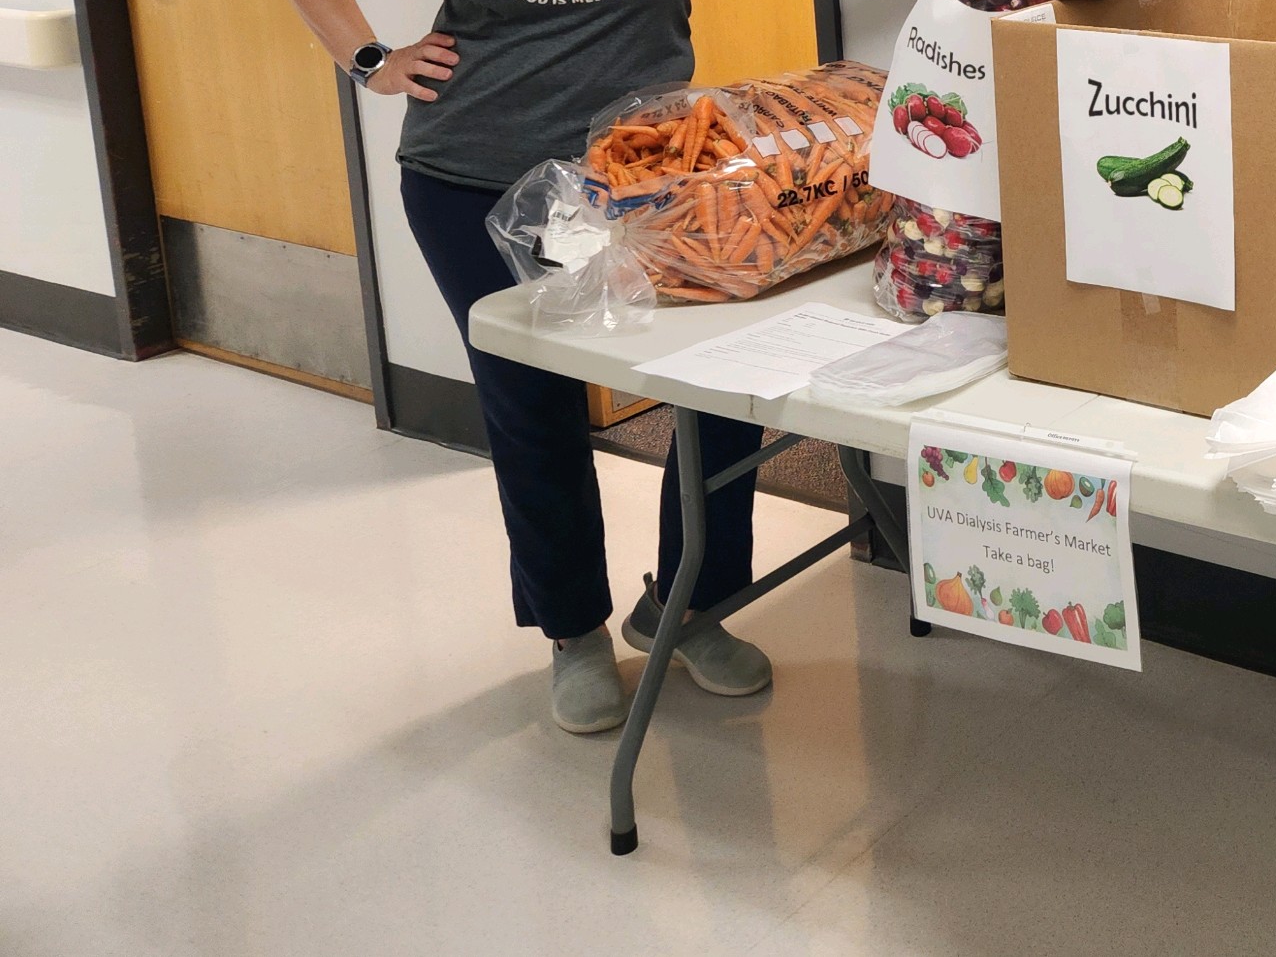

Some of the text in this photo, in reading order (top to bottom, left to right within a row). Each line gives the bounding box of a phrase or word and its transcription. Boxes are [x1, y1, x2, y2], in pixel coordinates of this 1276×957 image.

[906, 26, 986, 80] Radishes
[1087, 78, 1198, 129] Zucchini
[927, 506, 1112, 557] UVA Dialysis Farmer's Market
[982, 545, 1054, 574] Take a bag!
